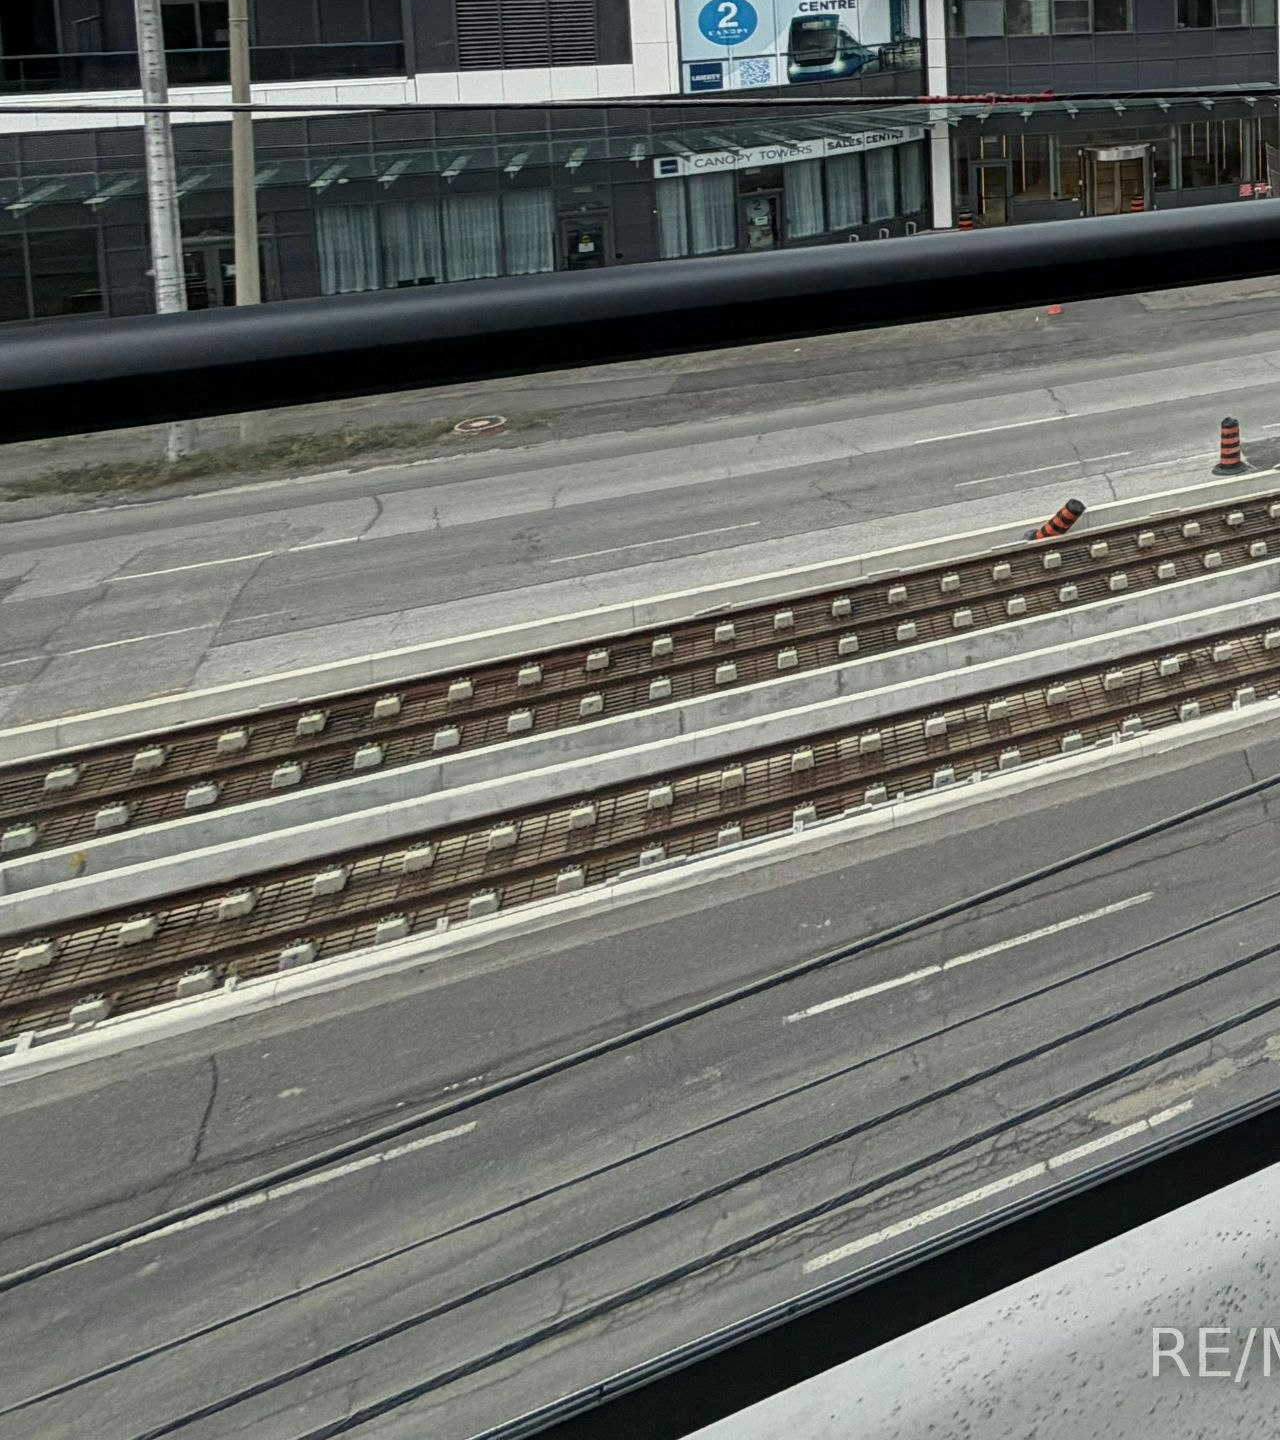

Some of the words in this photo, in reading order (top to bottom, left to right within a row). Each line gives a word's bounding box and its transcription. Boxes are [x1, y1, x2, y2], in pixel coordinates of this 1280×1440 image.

[717, 1, 739, 28] 2
[694, 153, 753, 168] CANOPY
[759, 144, 813, 160] TOWERS
[827, 137, 863, 150] SALES
